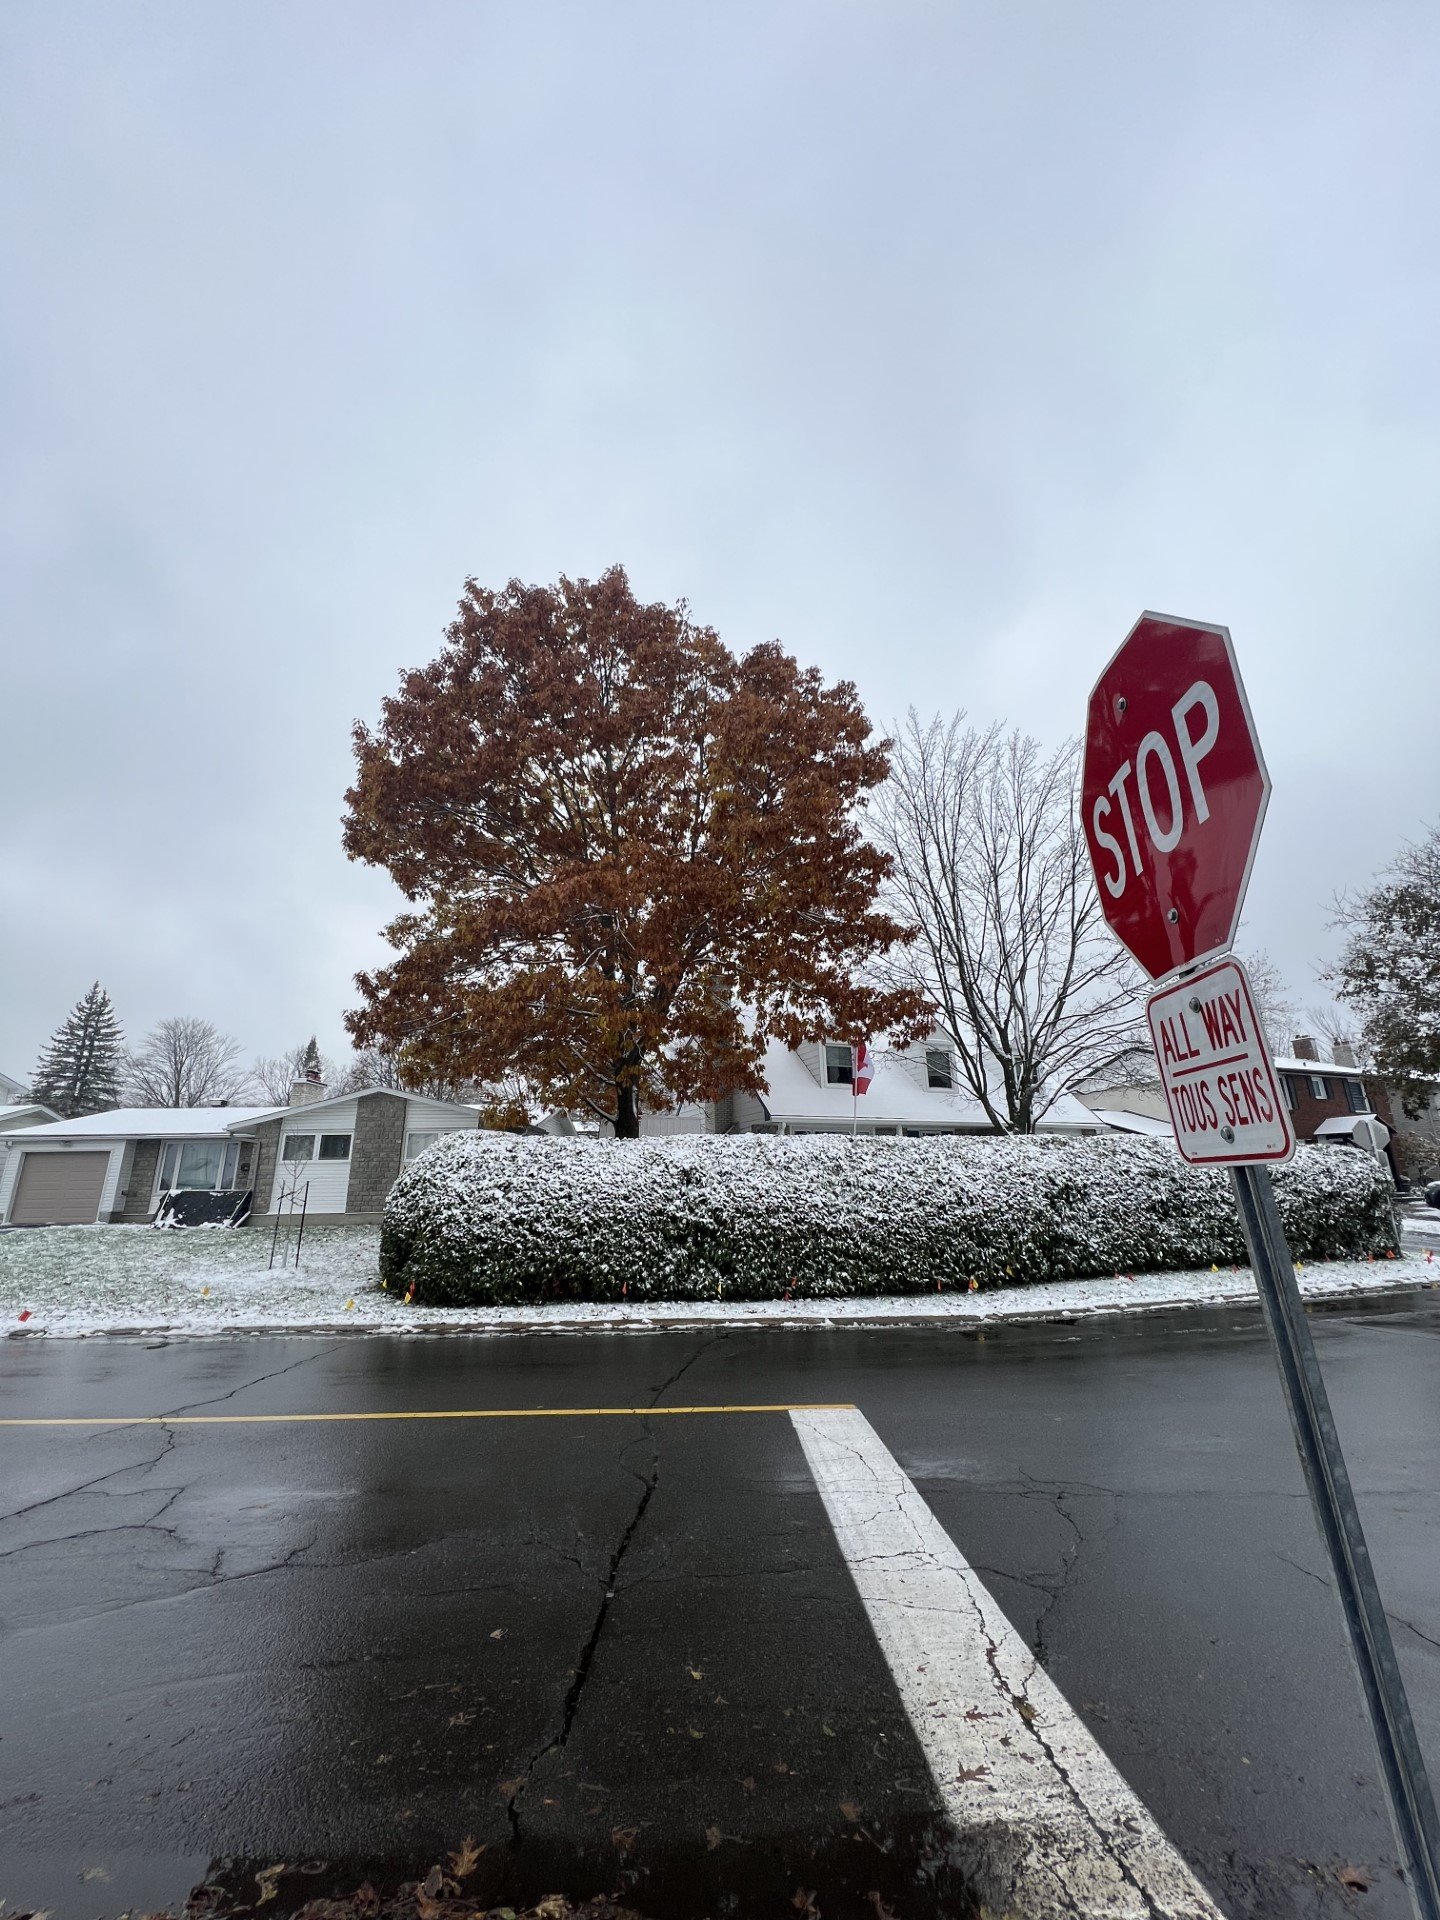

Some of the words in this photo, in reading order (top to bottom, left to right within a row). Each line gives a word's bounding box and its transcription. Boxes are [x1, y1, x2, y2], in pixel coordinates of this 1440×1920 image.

[1093, 680, 1220, 899] STOP
[1160, 1012, 1200, 1065] ALL
[1199, 989, 1247, 1050] WAY
[1171, 1080, 1218, 1133] TOUS
[1217, 1067, 1273, 1127] SENS
